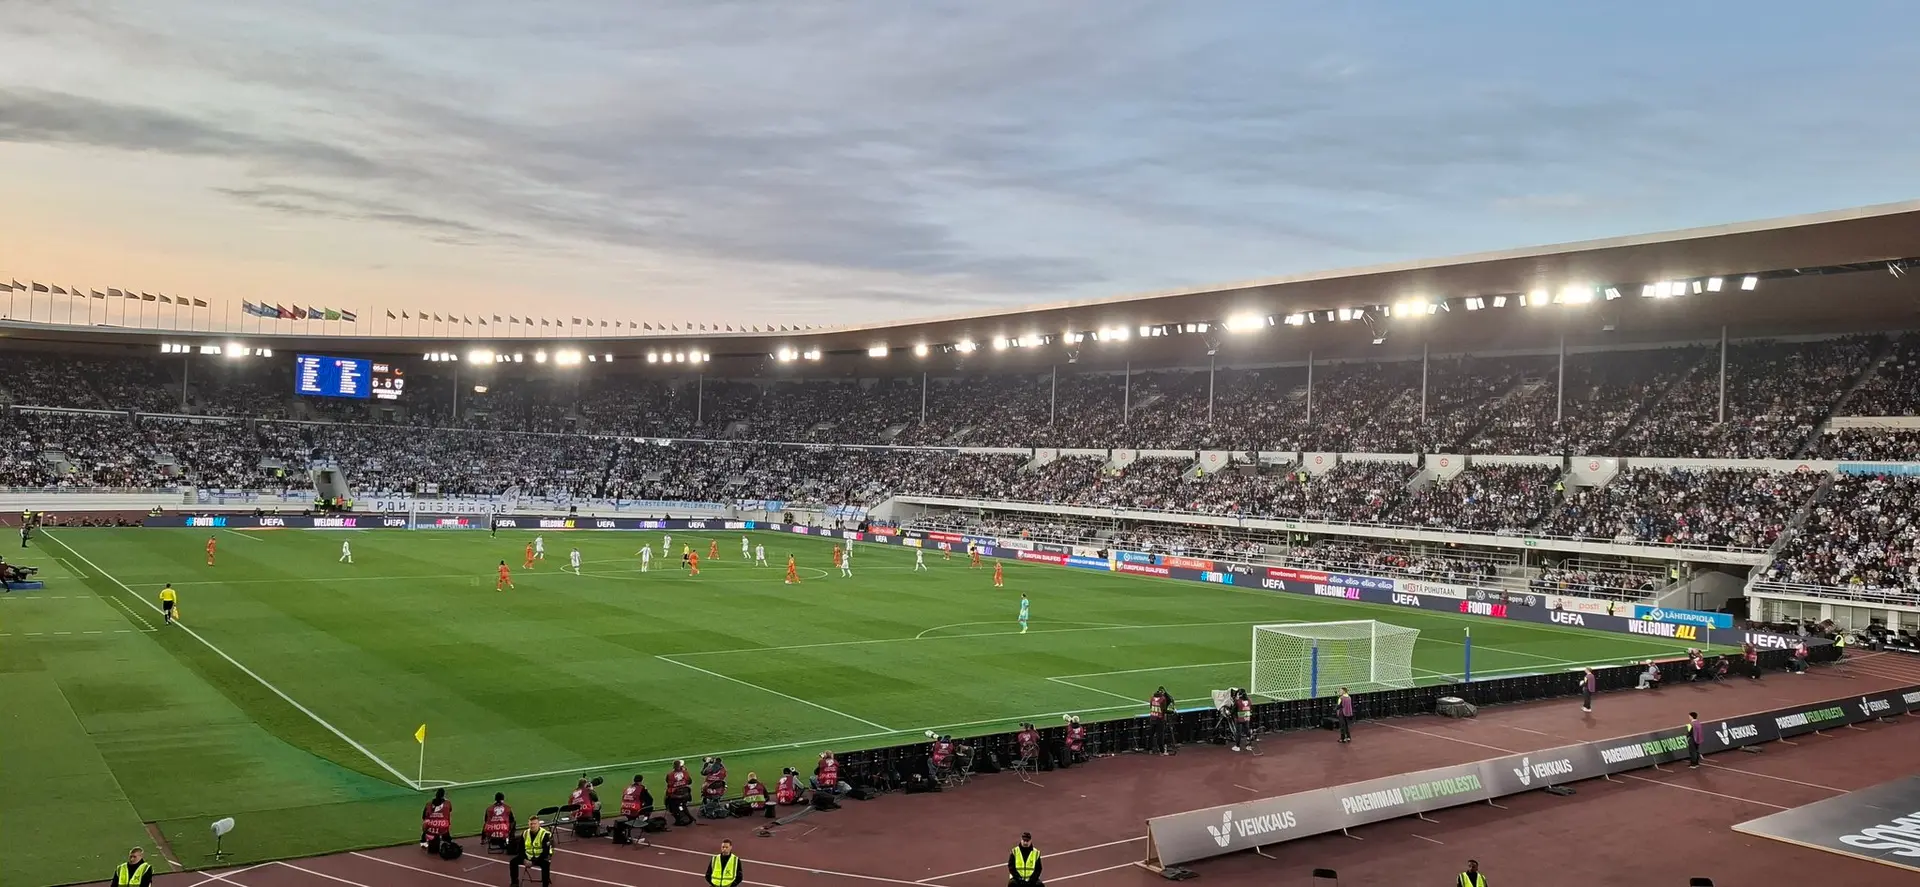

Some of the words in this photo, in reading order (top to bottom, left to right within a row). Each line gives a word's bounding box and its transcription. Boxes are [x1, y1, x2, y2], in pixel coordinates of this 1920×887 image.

[185, 517, 226, 527] #FOOTBALL
[259, 518, 285, 526] UEFA
[313, 517, 344, 527] WELCOME
[343, 517, 357, 527] ALL
[383, 519, 406, 527] UEFA
[496, 519, 516, 528] UEFA
[564, 519, 576, 528] ALL
[596, 520, 616, 528] UEFA
[687, 521, 706, 529] UEFA
[1123, 564, 1145, 572] EUROPEAN
[1145, 566, 1169, 574] QUALIFIERS
[1200, 570, 1234, 585] #FOOTBALL
[1262, 578, 1286, 590] UEFA
[1313, 583, 1347, 598] WELCOME
[1345, 587, 1361, 600] ALL
[1391, 593, 1420, 607] UEFA
[1459, 600, 1508, 617] #FOOTBALL
[1550, 610, 1585, 626] UEFA
[1664, 610, 1716, 624] LÄHITAPIOLA
[1628, 619, 1676, 637] WELCOME
[1675, 625, 1697, 640] ALL
[1745, 632, 1788, 649] UEFA
[1728, 723, 1758, 740] VEIKKAUS
[1601, 743, 1645, 764] PAREMMAN
[1641, 740, 1664, 756] PELIN
[1661, 735, 1689, 752] PUOLEST
[1531, 758, 1574, 778] VEIKKAUS
[1341, 787, 1405, 815] PAREMMAN
[1401, 781, 1434, 803] PELIN
[1431, 774, 1483, 797] PUOLESTA
[1234, 810, 1297, 837] VEIKKAUS
